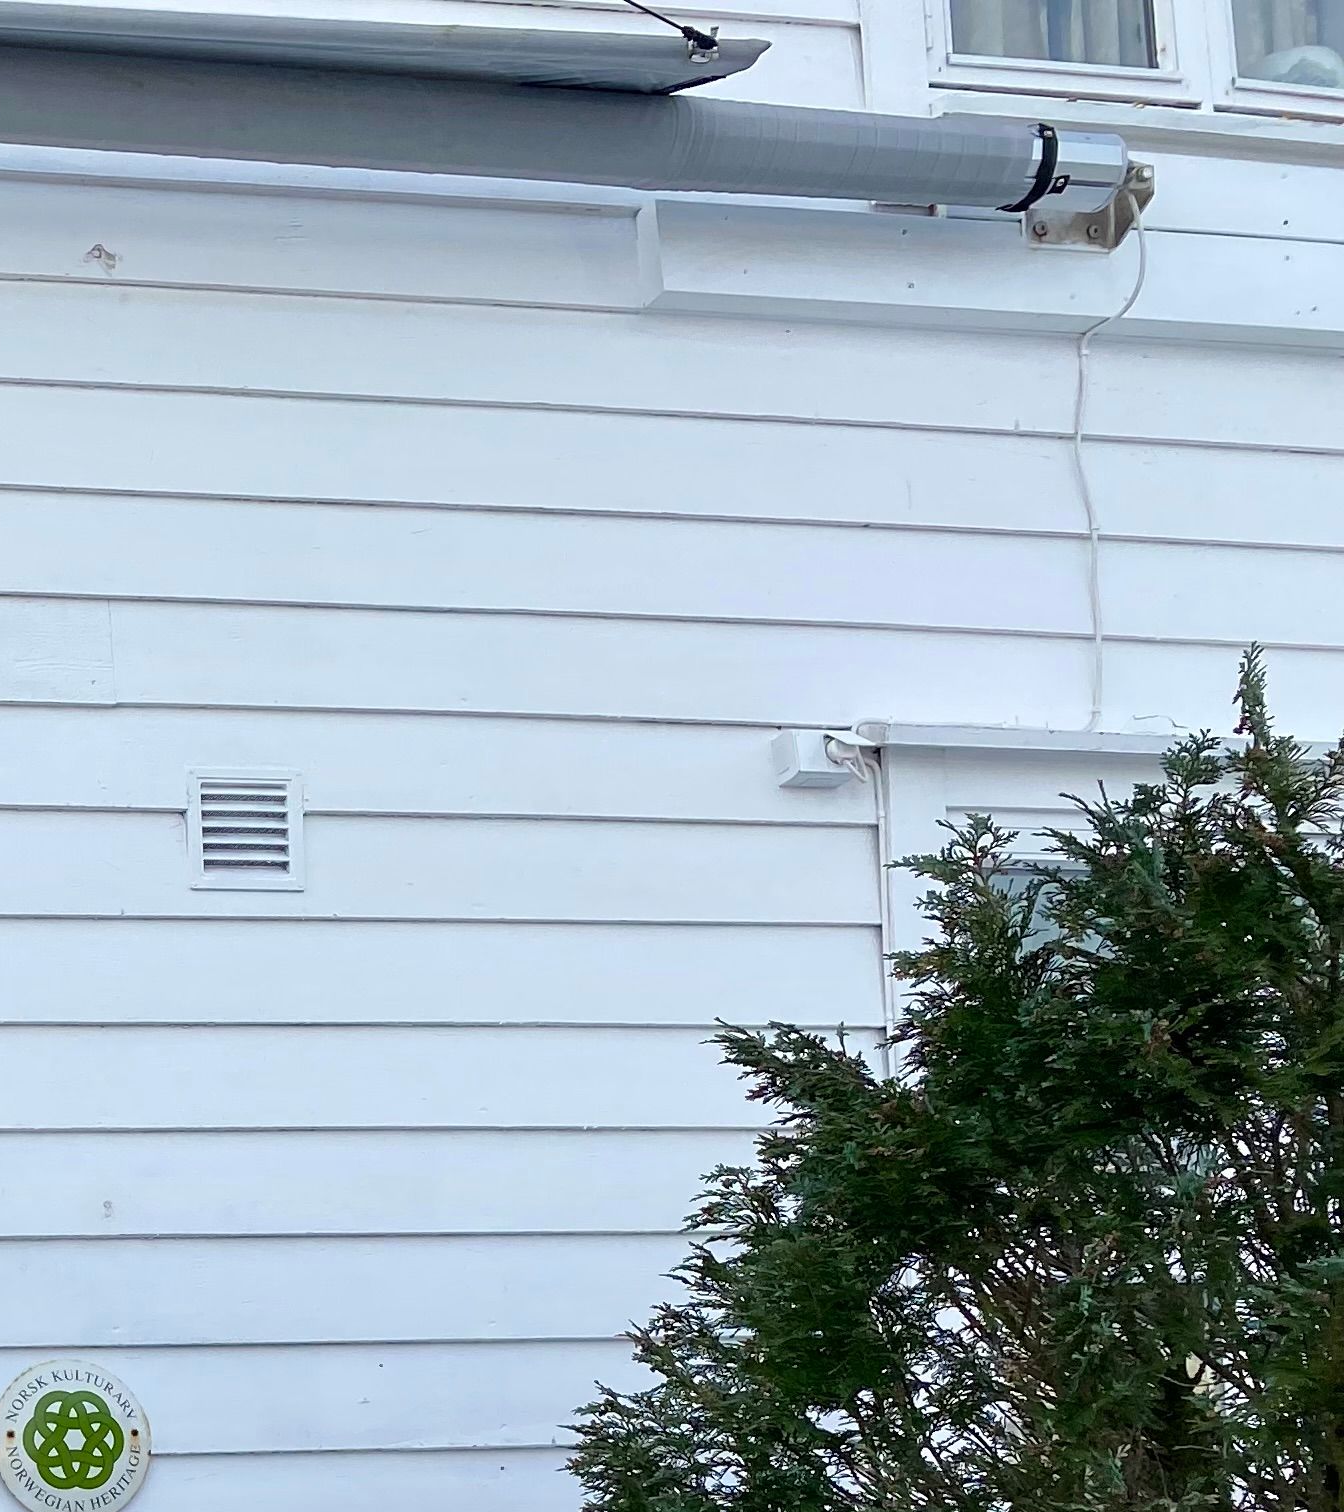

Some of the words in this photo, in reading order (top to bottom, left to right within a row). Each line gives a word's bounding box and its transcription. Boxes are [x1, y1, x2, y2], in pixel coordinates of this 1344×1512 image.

[5, 1375, 48, 1423] NORSK
[51, 1369, 138, 1420] KULTURARV
[6, 1446, 85, 1512] NORWEGIAN
[91, 1445, 141, 1511] HERITAGE
